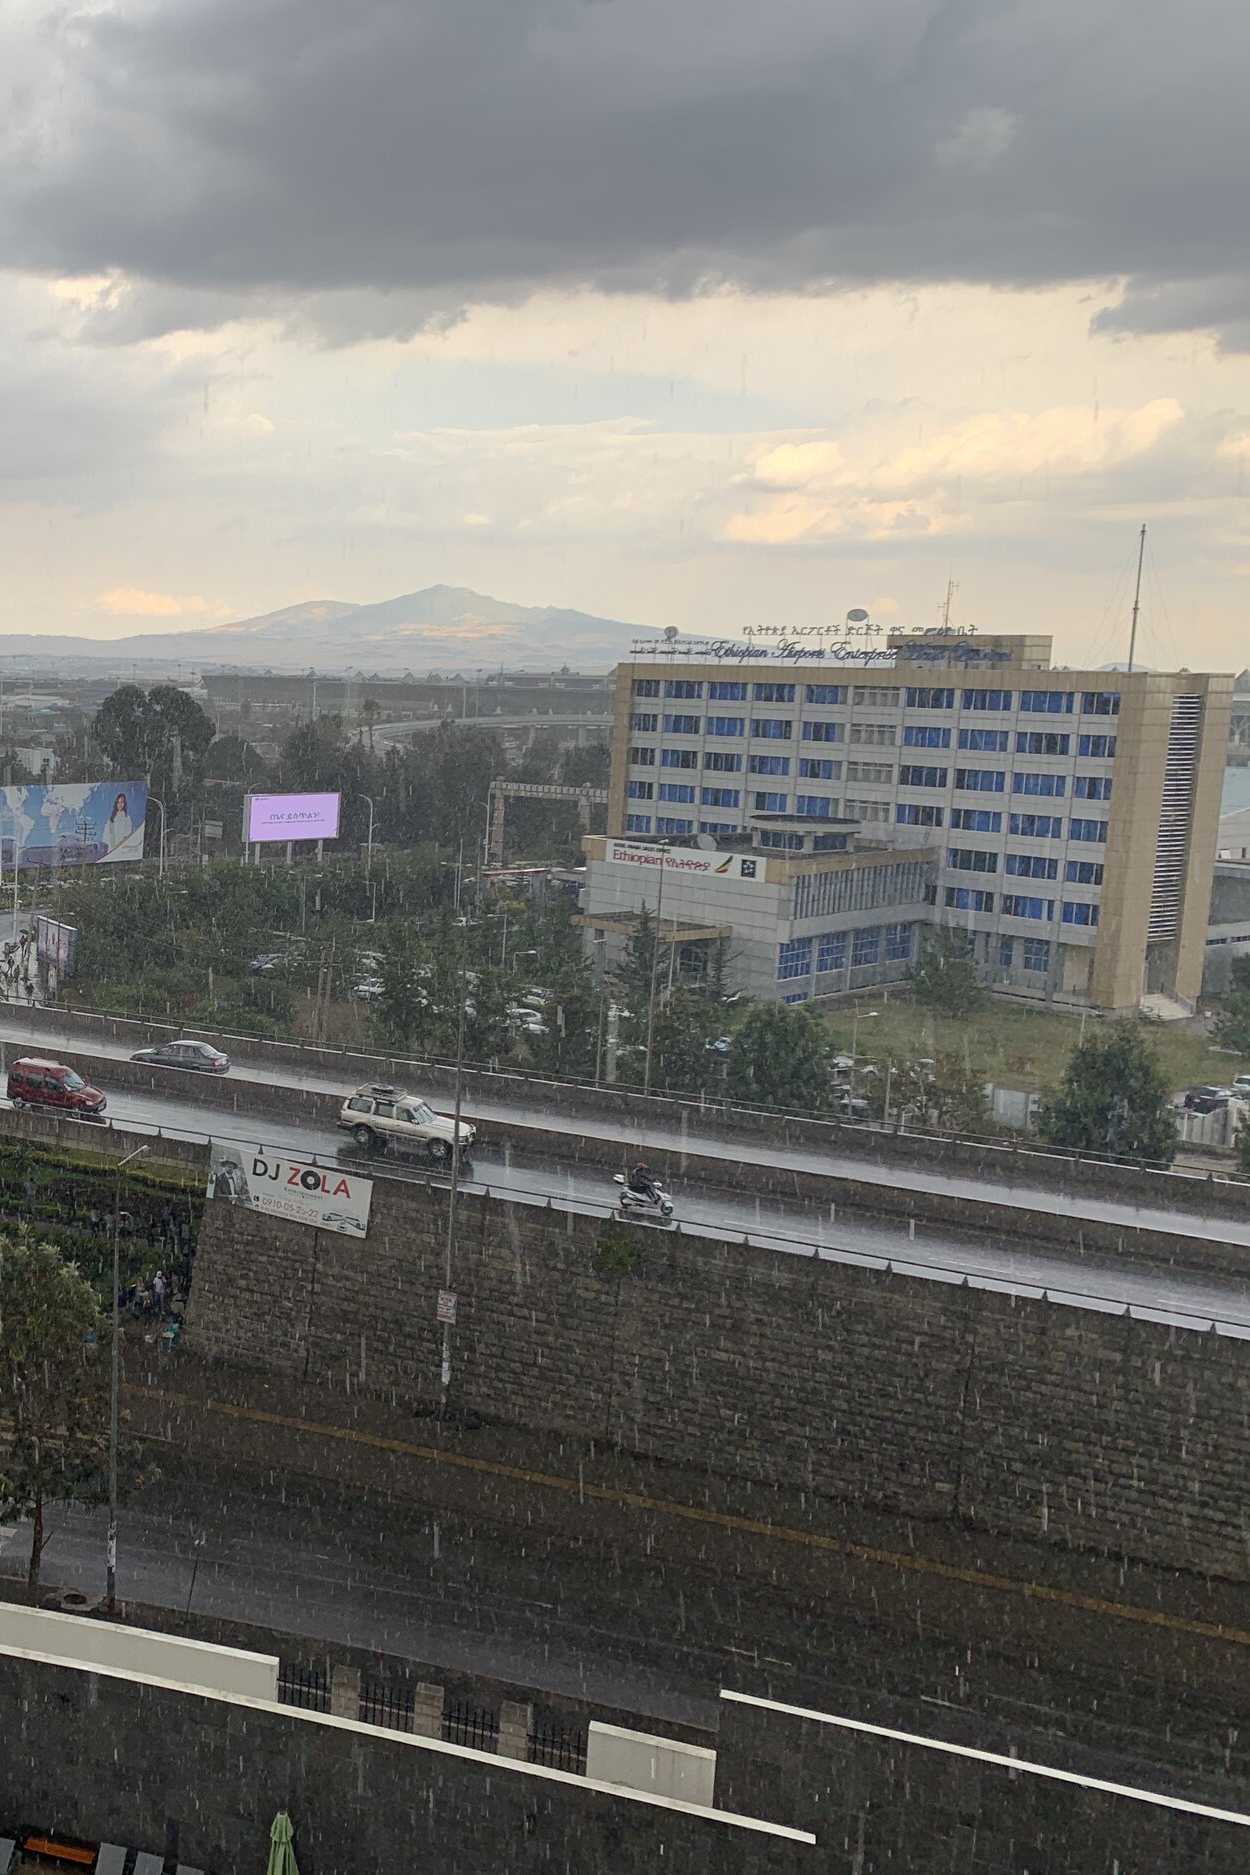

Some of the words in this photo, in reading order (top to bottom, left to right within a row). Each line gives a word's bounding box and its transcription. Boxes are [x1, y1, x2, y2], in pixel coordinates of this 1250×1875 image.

[710, 640, 769, 664] Ethiopian
[771, 639, 826, 664] Airports
[831, 641, 899, 667] Enterprise
[613, 849, 663, 865] Ethiopian
[252, 1158, 280, 1181] DJ
[286, 1167, 351, 1199] ZOLA
